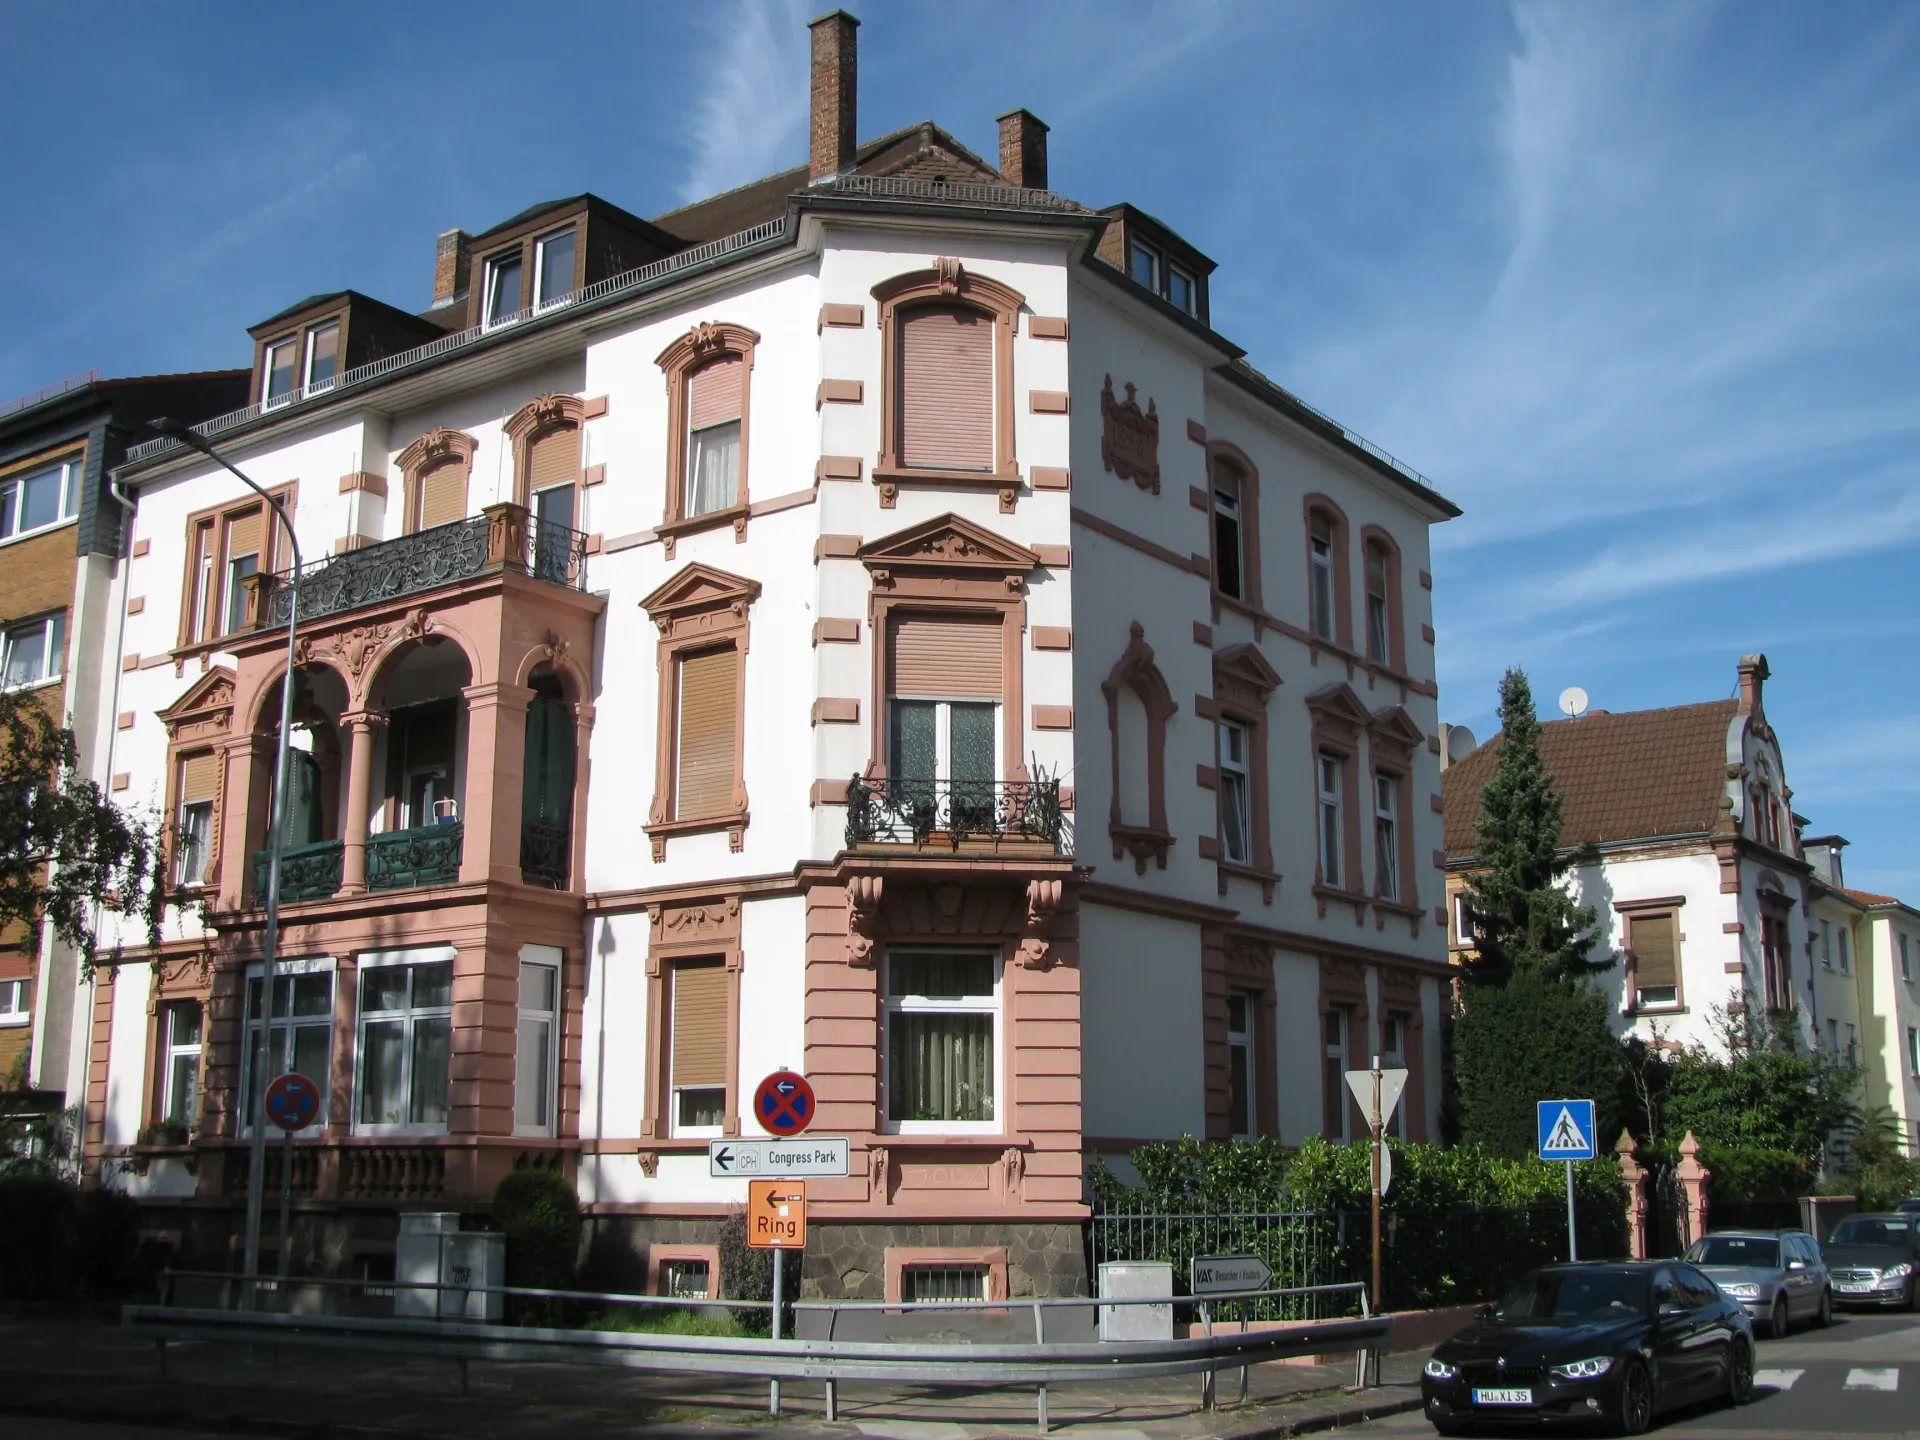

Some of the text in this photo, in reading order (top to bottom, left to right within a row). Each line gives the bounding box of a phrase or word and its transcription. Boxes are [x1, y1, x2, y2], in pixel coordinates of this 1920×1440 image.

[740, 1150, 836, 1169] CPH Congress Park
[758, 1216, 796, 1237] Ring
[1481, 1391, 1494, 1402] HU
[1515, 1391, 1528, 1402] 35
